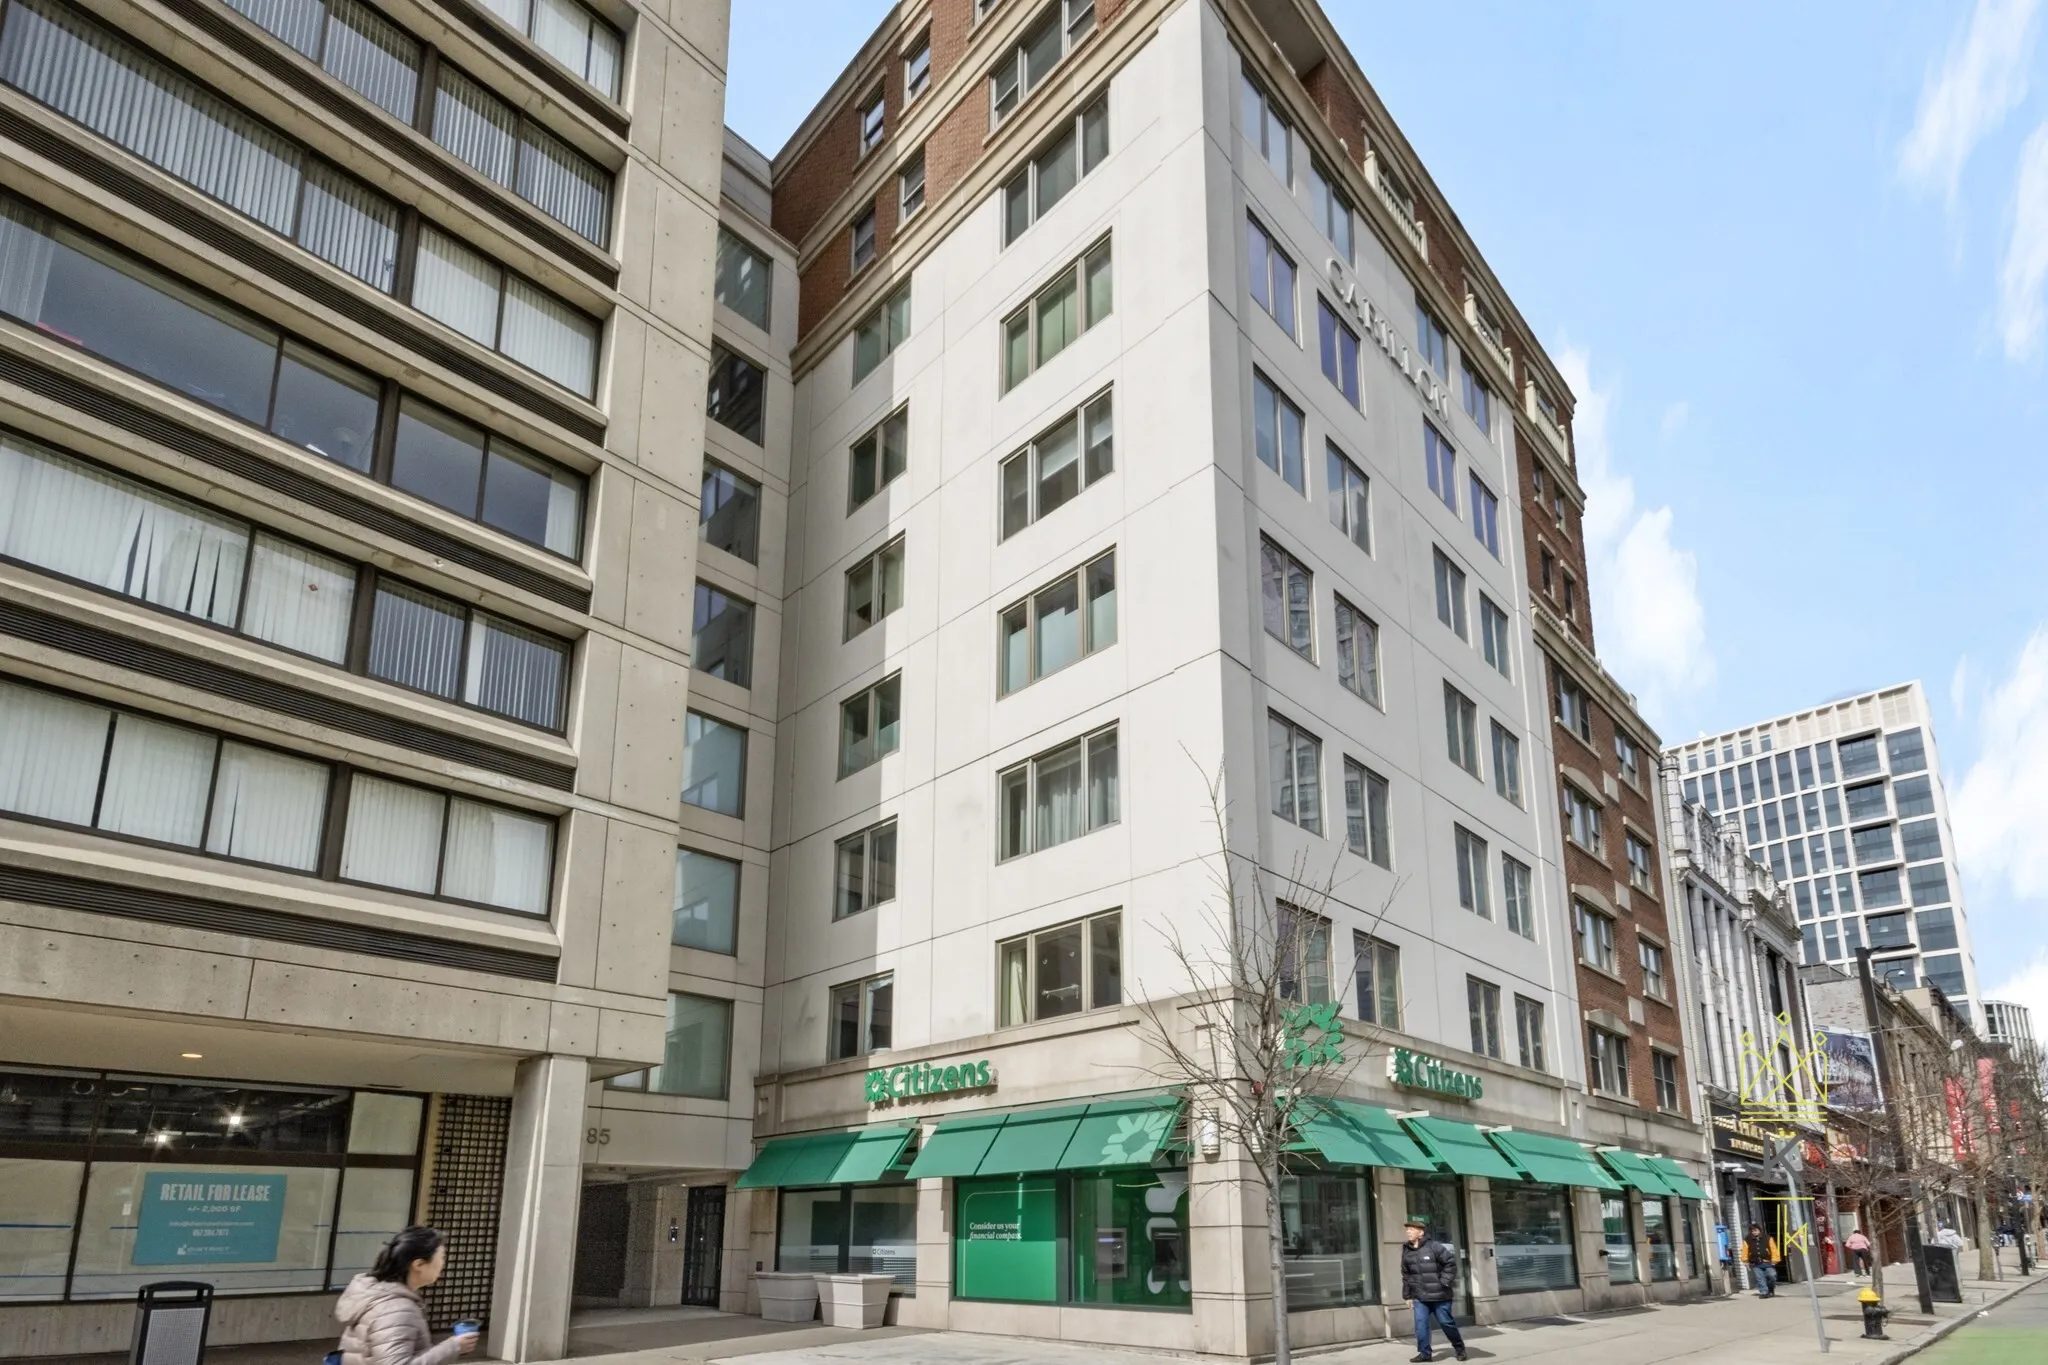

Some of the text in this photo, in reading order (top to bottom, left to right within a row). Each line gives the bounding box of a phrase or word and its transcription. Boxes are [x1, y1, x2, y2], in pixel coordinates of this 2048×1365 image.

[888, 1060, 990, 1097] Citizens
[1415, 1055, 1483, 1099] Citizens
[586, 1127, 611, 1145] 85
[160, 1183, 271, 1201] RETAIL FOR LEASE
[970, 1222, 996, 1230] Consider
[1005, 1223, 1020, 1231] your
[968, 1232, 995, 1242] financial
